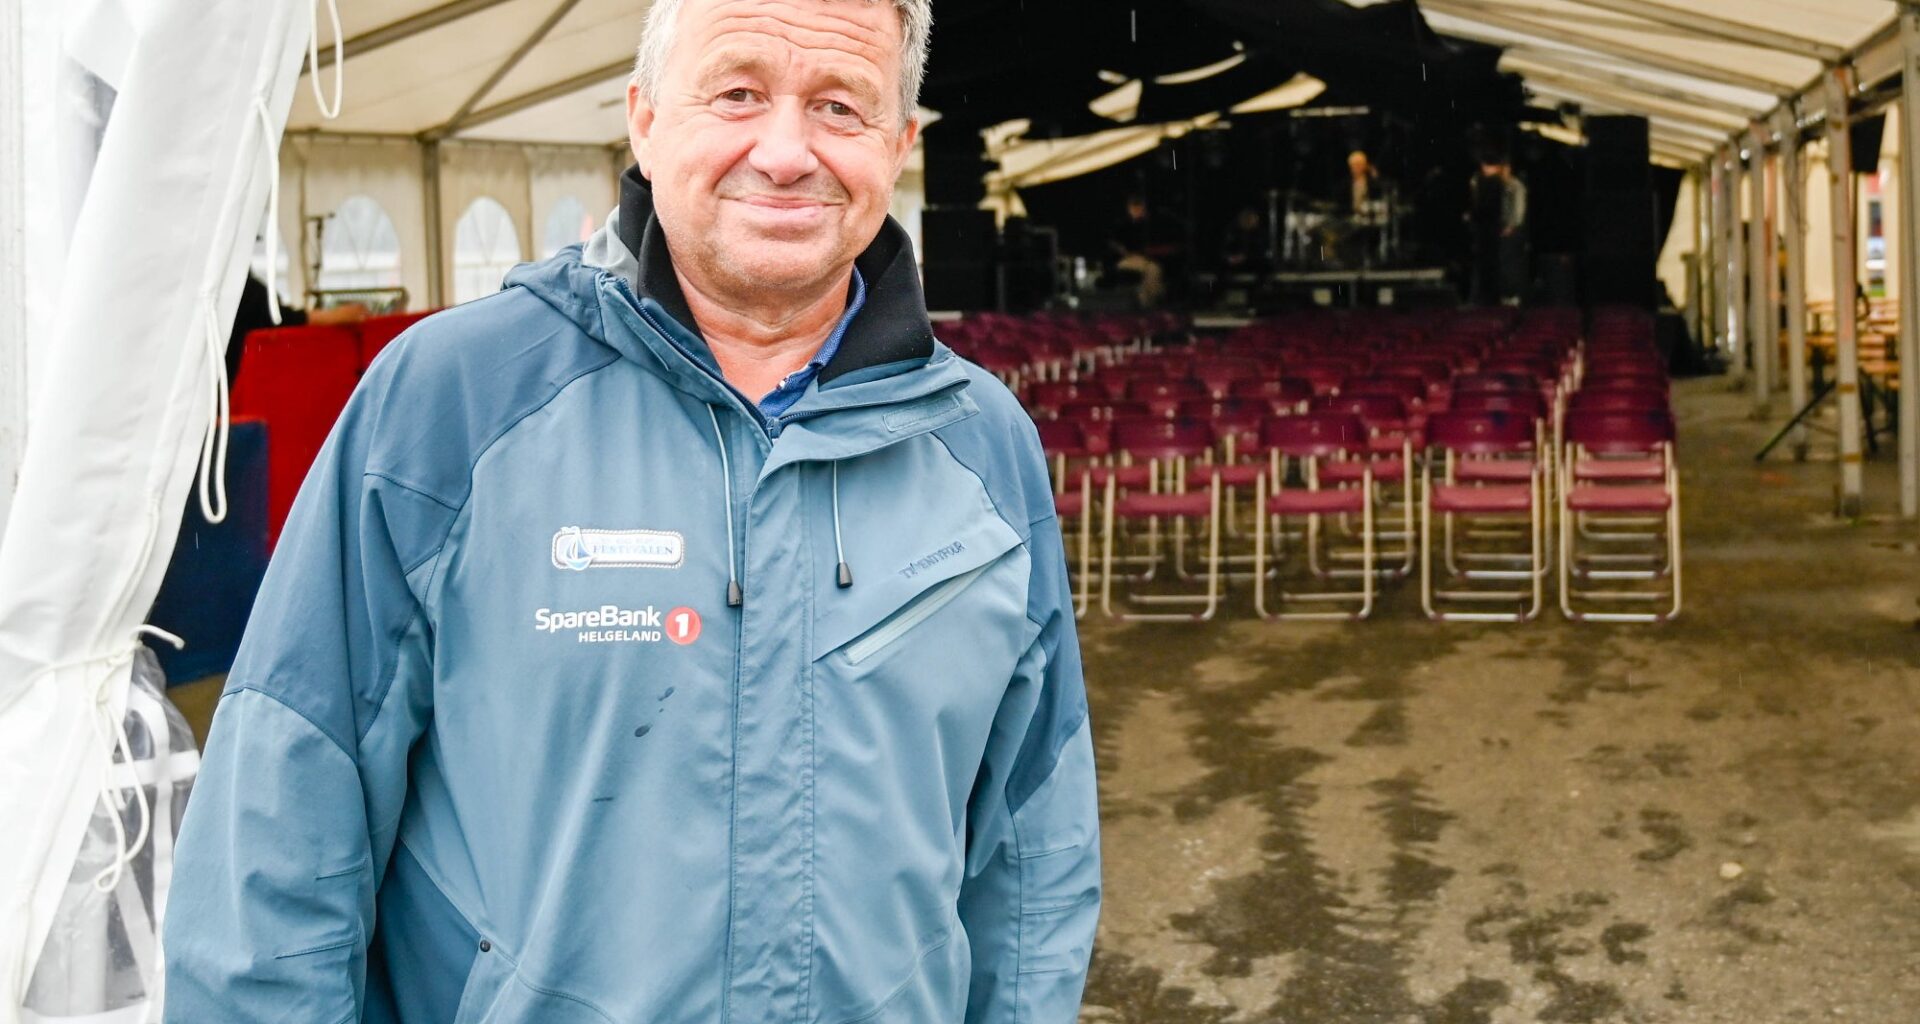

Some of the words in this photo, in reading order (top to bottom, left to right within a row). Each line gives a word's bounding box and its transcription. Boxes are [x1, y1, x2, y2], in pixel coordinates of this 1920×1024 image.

[593, 545, 673, 555] FESTIVALEN
[535, 605, 662, 634] SpareBank
[675, 613, 689, 638] 1
[578, 630, 662, 643] HELGELAND
